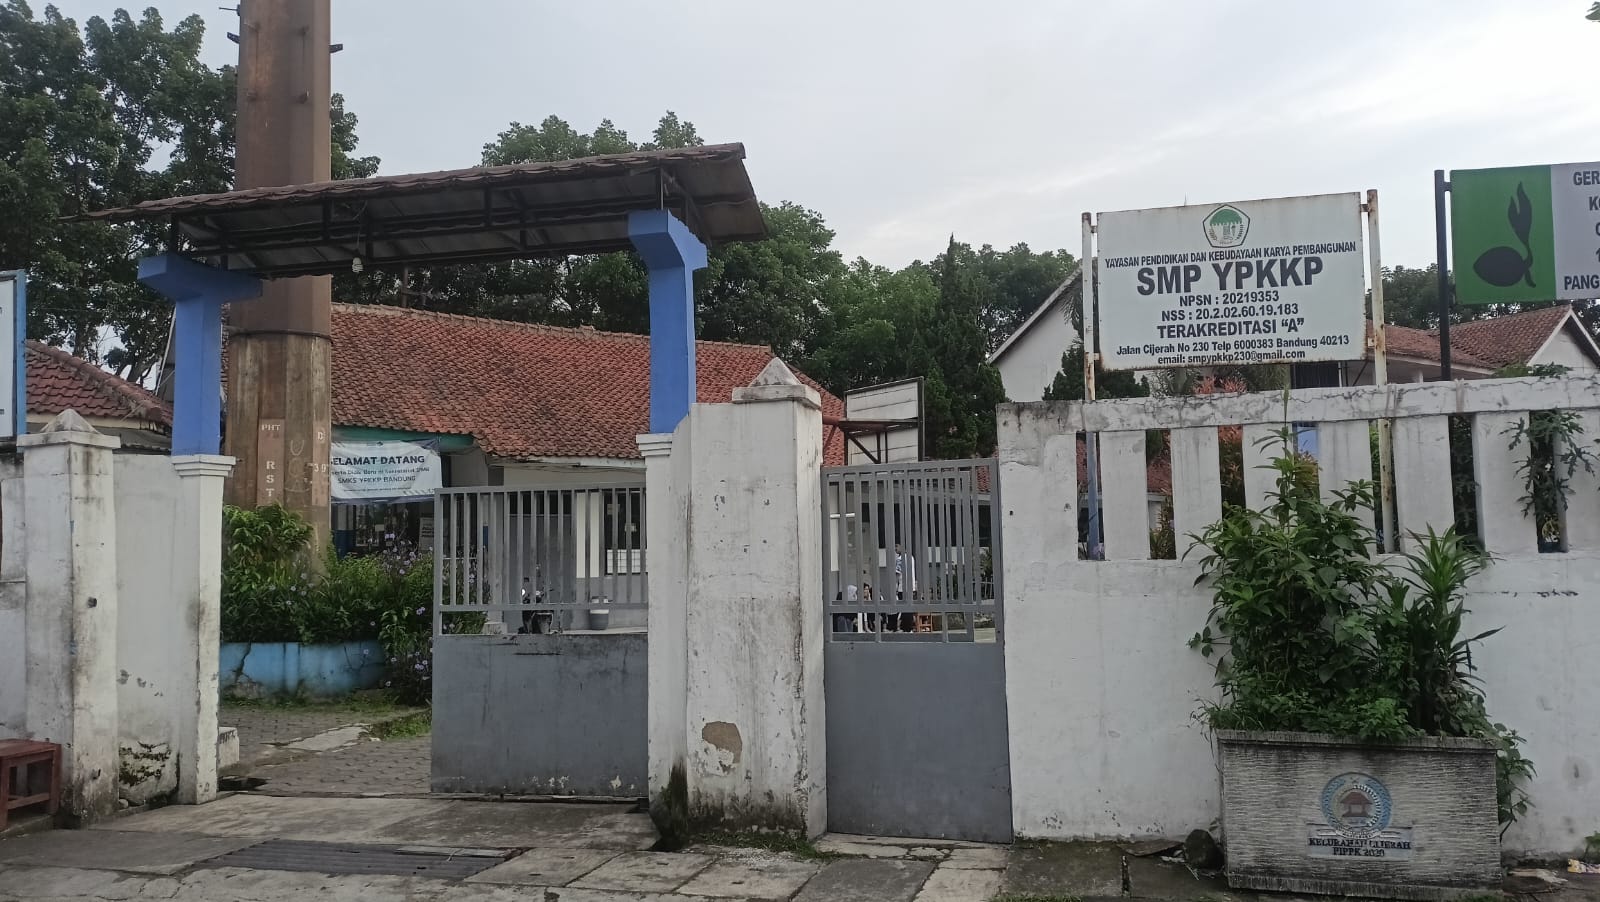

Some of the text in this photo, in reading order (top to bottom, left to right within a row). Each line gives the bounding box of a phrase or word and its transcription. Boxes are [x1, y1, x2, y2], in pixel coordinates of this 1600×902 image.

[1573, 170, 1600, 187] GER
[1589, 196, 1600, 211] K
[1105, 241, 1356, 268] YAYASAN PENDIDIKAN DAN KEBUDAYAAN KARYA PEMBANGUNAN
[1137, 256, 1323, 296] SMP YPKKP
[1180, 294, 1212, 307] NPSN
[1222, 291, 1280, 305] 20219353
[1161, 309, 1185, 322] NSS
[1195, 303, 1299, 320] 20.2.02.60.19.183
[1157, 319, 1277, 339] TERAKREDITASI
[1116, 334, 1350, 357] Jalan Cijerah No 230 Telp 6000383 Bandung 40213
[1157, 349, 1306, 365] email: smpypkkp230@gmail.com
[380, 455, 425, 464] DATANG
[383, 475, 416, 483] BANDUNG
